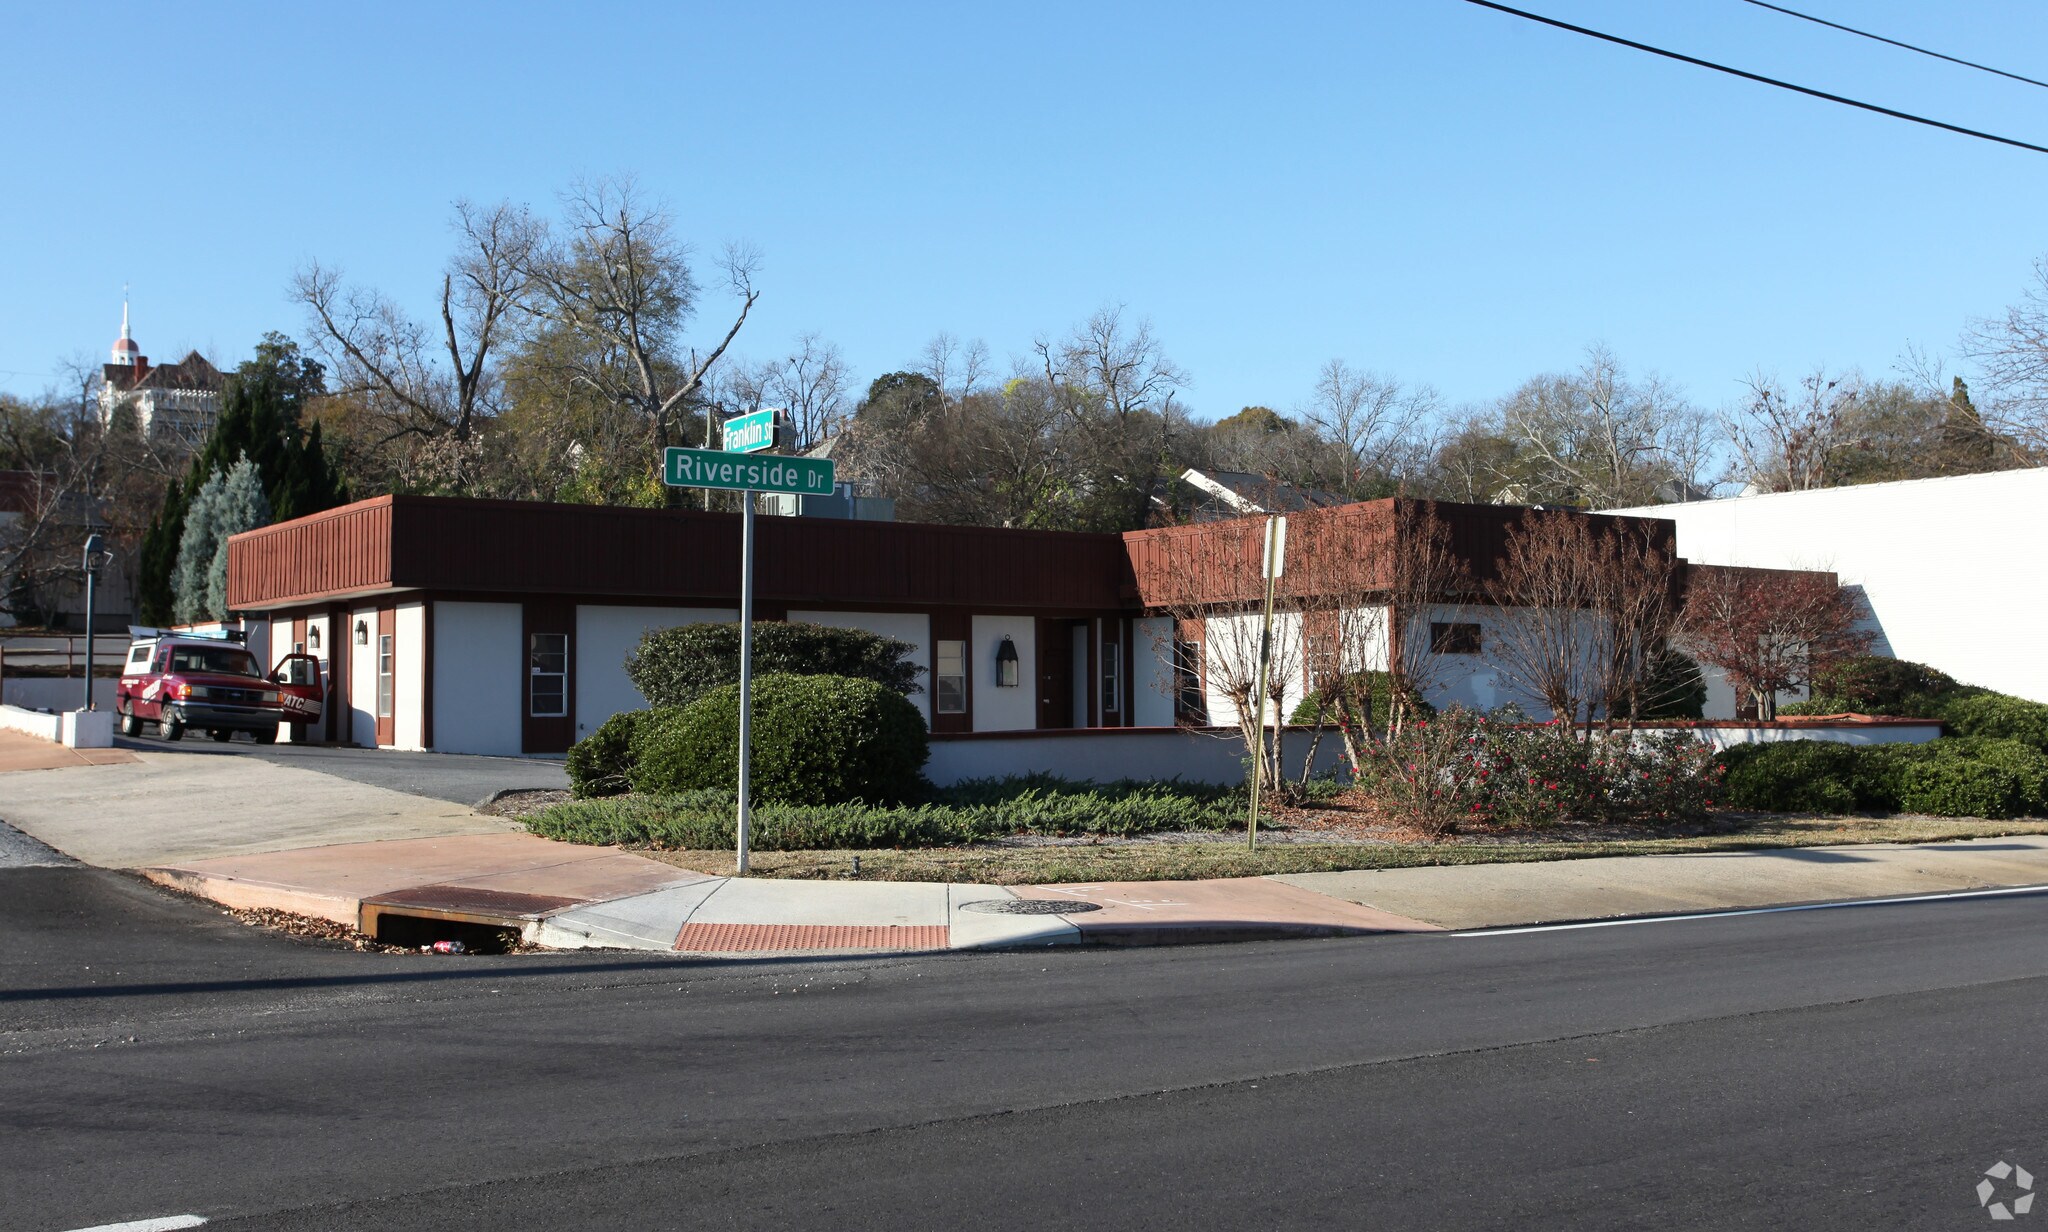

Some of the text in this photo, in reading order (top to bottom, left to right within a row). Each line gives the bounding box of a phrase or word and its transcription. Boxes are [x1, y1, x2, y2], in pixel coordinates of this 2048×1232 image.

[724, 420, 762, 451] Franklin
[677, 454, 824, 488] Riverside Dr
